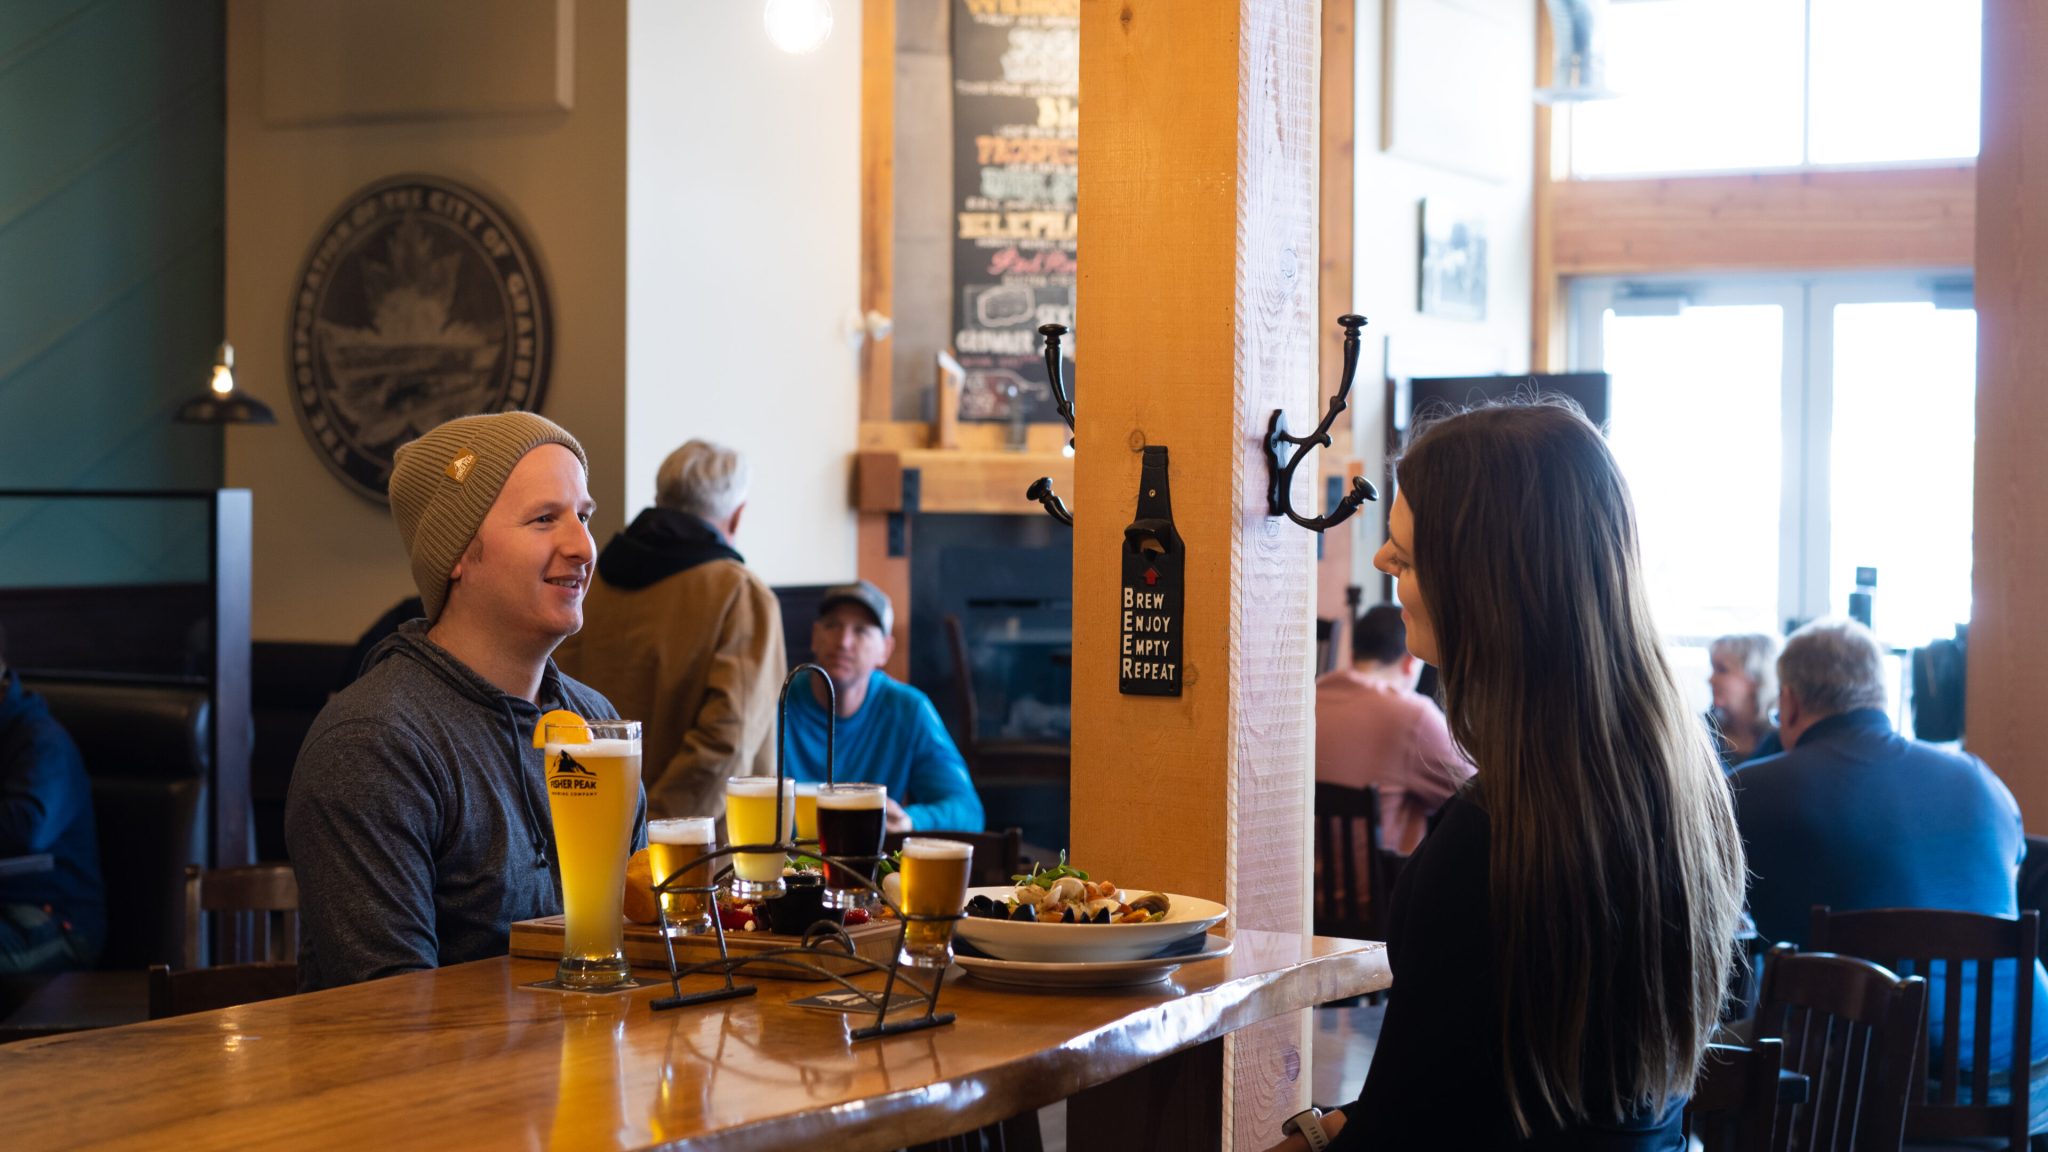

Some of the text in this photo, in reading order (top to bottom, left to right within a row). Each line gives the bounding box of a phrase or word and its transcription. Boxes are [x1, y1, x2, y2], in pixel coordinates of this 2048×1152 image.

[428, 190, 484, 229] CITY
[1124, 587, 1164, 609] BREW
[1123, 611, 1170, 632] ENJOY
[1123, 634, 1169, 656] EMPTY
[1122, 658, 1175, 680] REPEAT
[574, 779, 596, 789] PEAK
